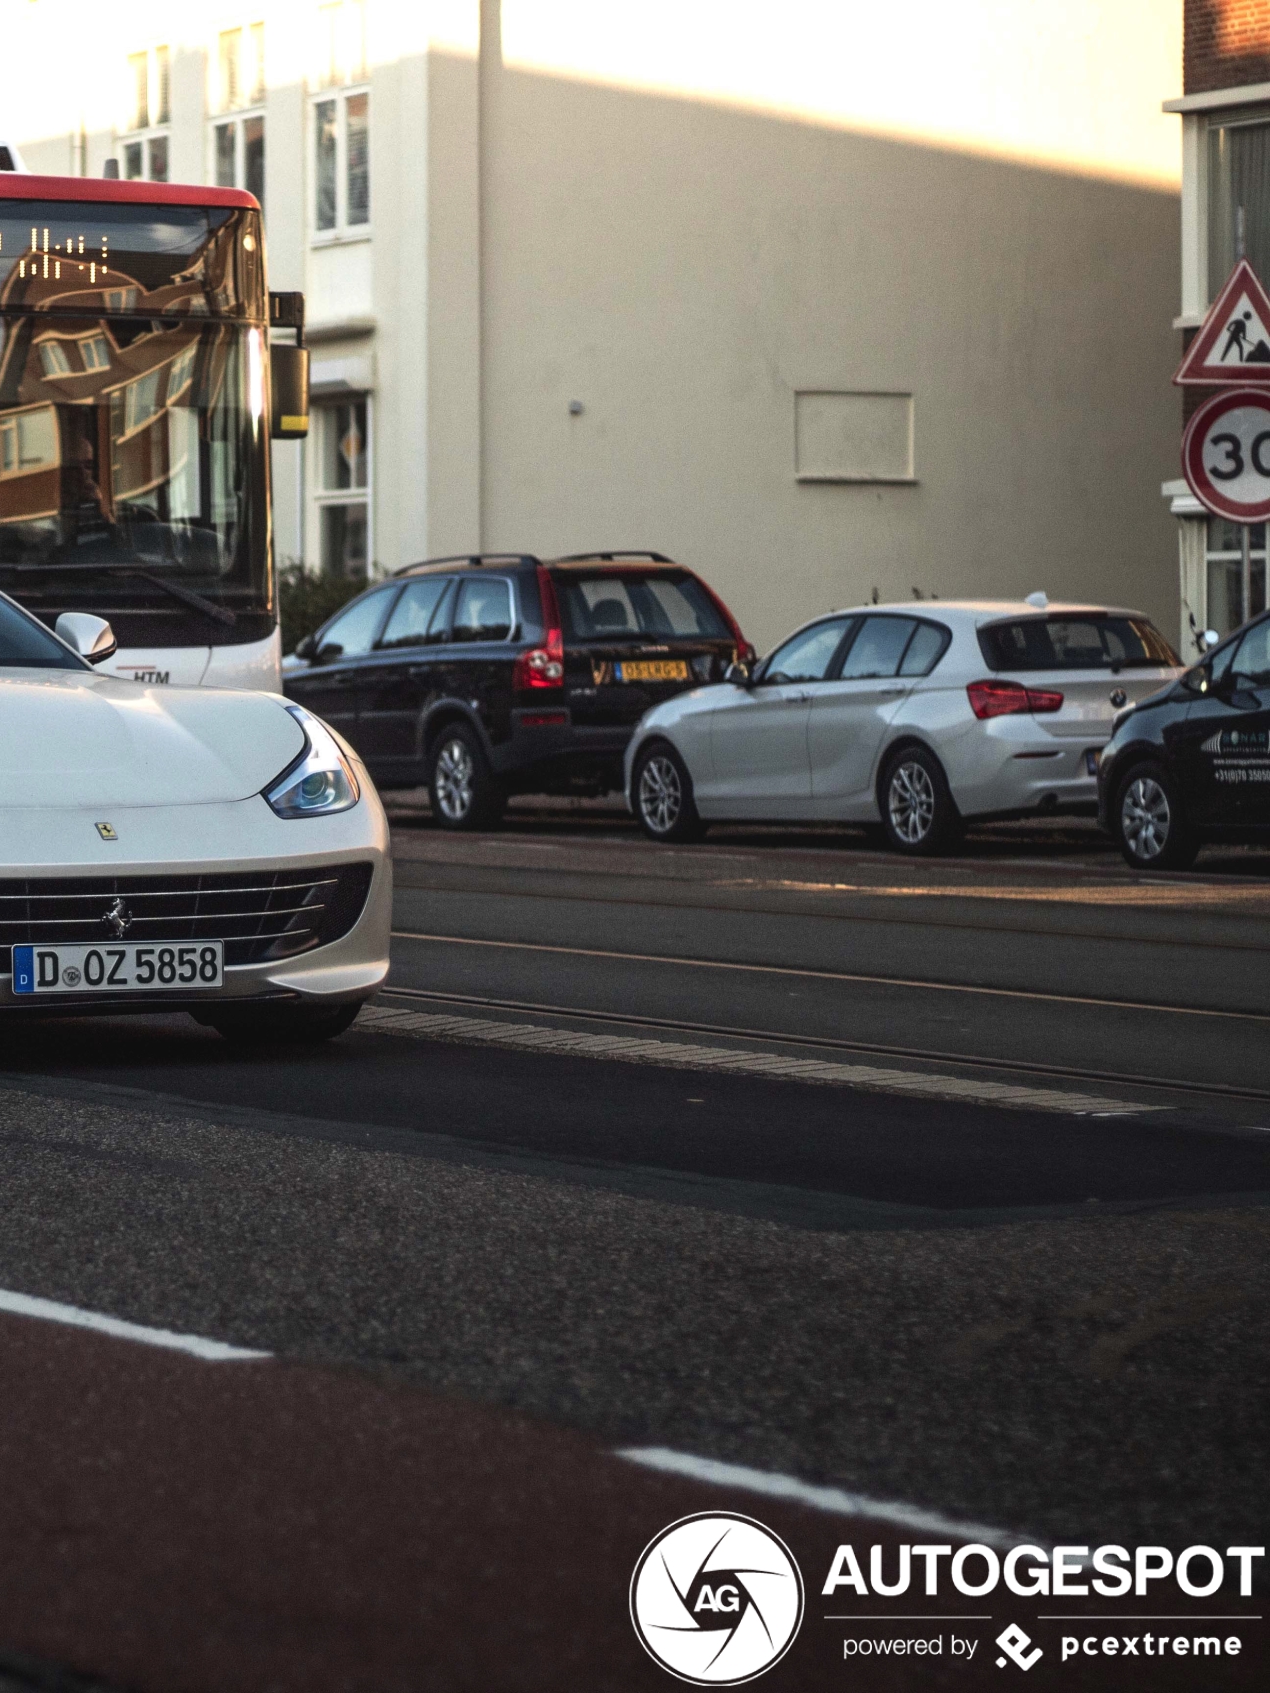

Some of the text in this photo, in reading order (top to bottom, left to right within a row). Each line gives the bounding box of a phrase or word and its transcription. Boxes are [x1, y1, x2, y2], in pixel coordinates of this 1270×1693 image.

[134, 671, 170, 684] HTM
[36, 946, 218, 987] D OZ 5858
[20, 974, 28, 985] D
